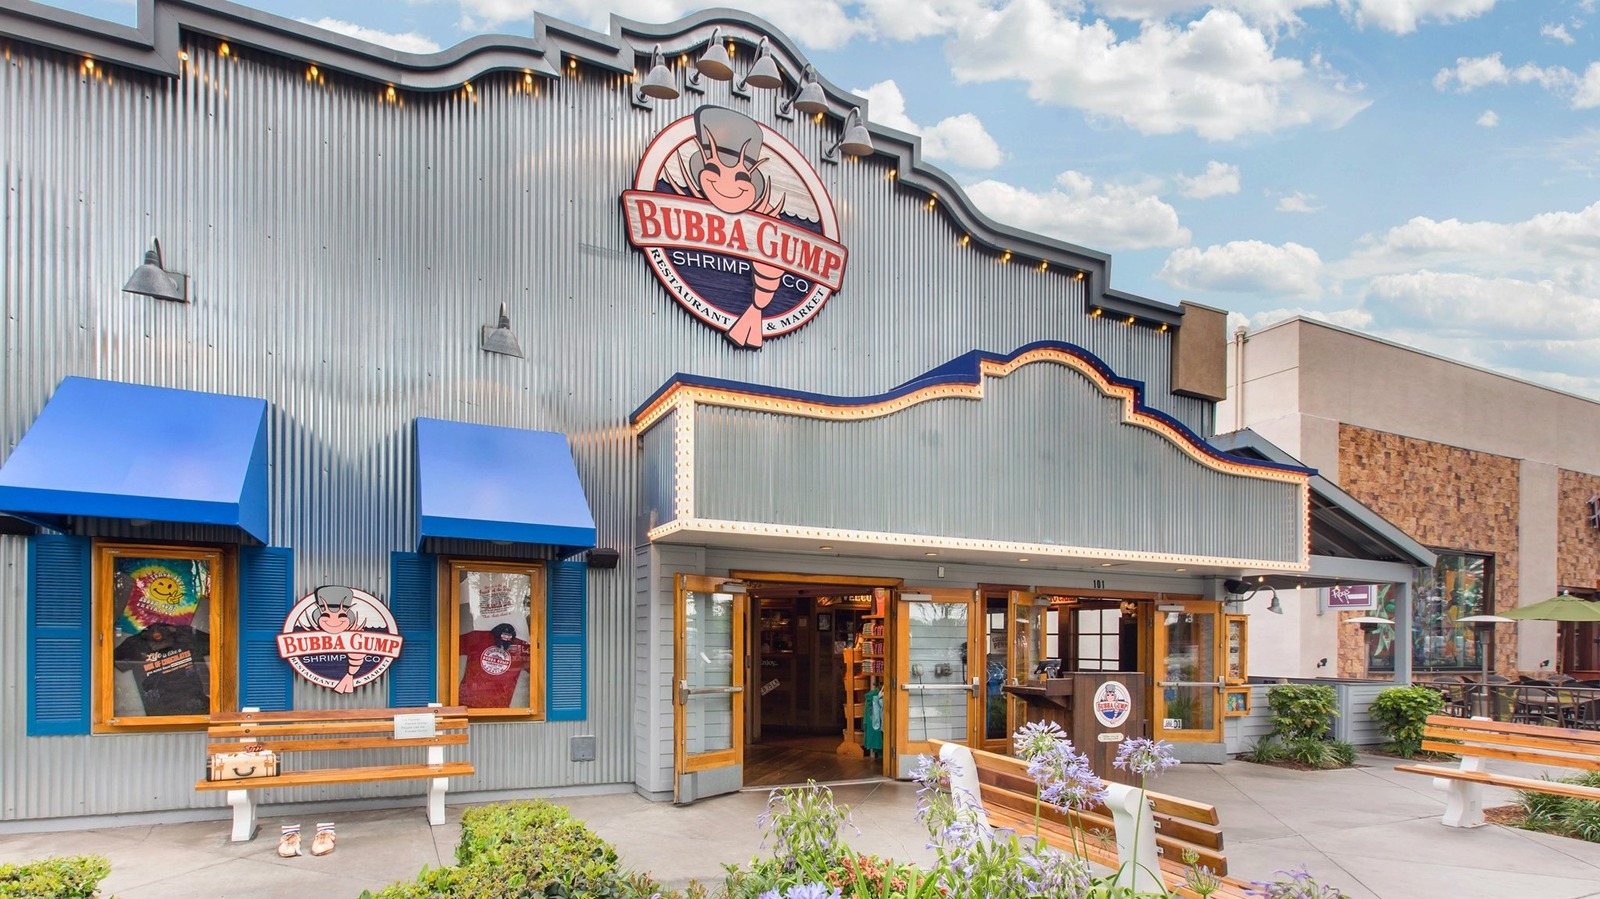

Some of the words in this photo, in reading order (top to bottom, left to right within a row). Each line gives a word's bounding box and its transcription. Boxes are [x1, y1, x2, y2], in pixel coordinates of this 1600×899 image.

[635, 199, 749, 251] BUBBA
[756, 221, 841, 280] GUMP
[673, 251, 751, 275] SHRIMP
[651, 248, 731, 326] RESTAURANT
[766, 321, 778, 331] &
[780, 287, 825, 328] MARKET
[1093, 579, 1105, 589] 101
[283, 635, 346, 655] BUBBA
[349, 633, 400, 654] GUMP
[145, 652, 162, 662] Life
[302, 654, 347, 664] SHRIMP
[291, 657, 336, 686] RESTAURANT
[364, 658, 390, 682] MARKET
